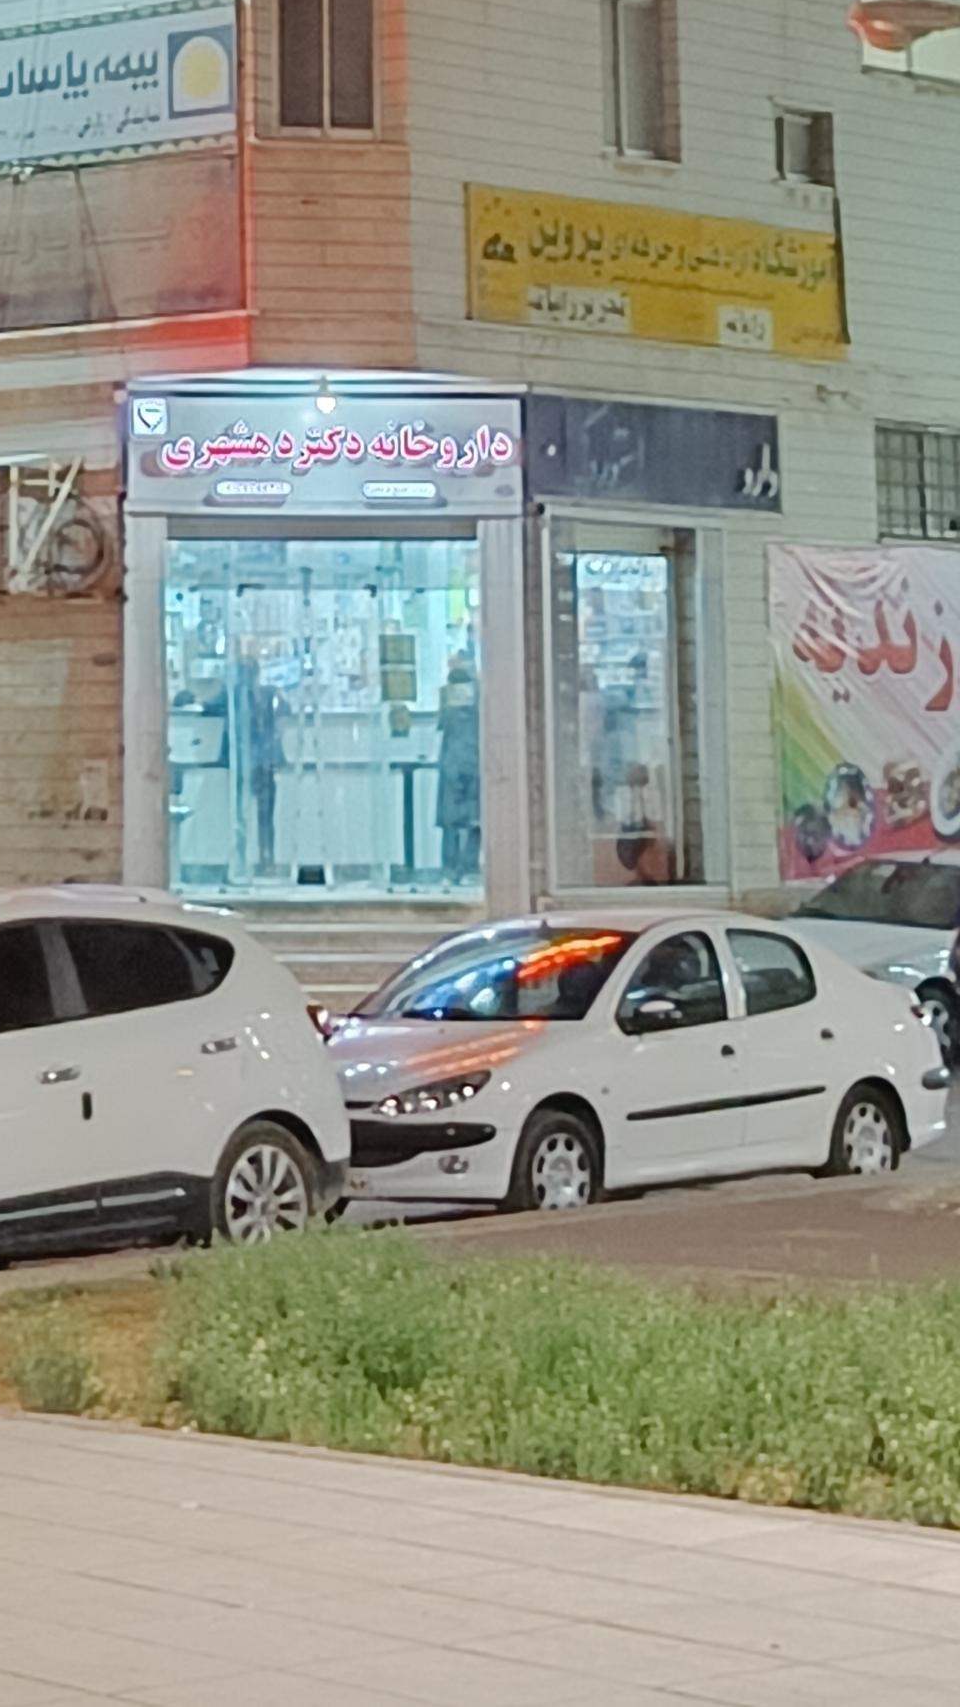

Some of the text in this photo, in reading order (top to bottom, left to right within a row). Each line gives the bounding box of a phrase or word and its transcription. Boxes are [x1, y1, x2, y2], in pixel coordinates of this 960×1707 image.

[93, 48, 160, 91] بیمه
[160, 418, 514, 470] داروخانه دکتر دهشهری
